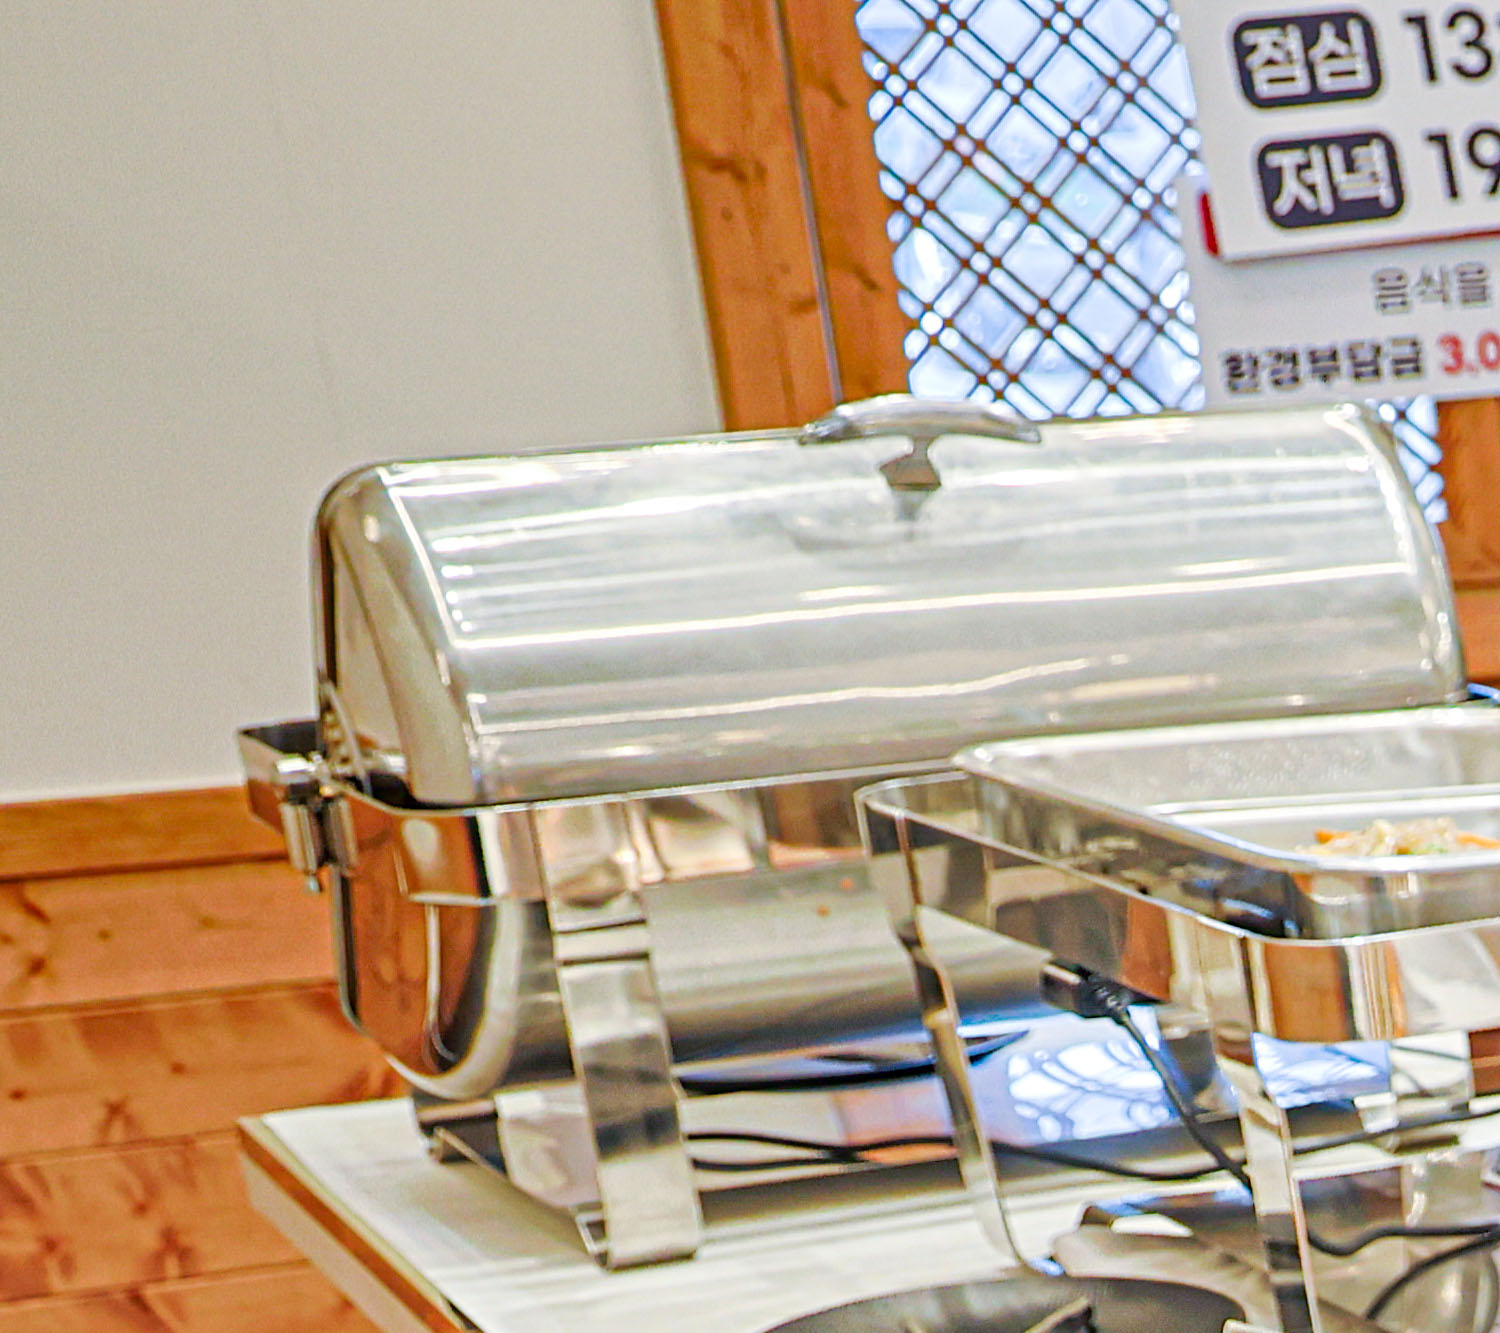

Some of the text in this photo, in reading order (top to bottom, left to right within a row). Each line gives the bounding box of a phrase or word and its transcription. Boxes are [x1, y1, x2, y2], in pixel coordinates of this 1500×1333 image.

[1241, 20, 1374, 98] 점심
[1264, 137, 1397, 219] 저녁
[1373, 260, 1491, 315] 음식을
[1222, 336, 1424, 394] 환경부담금
